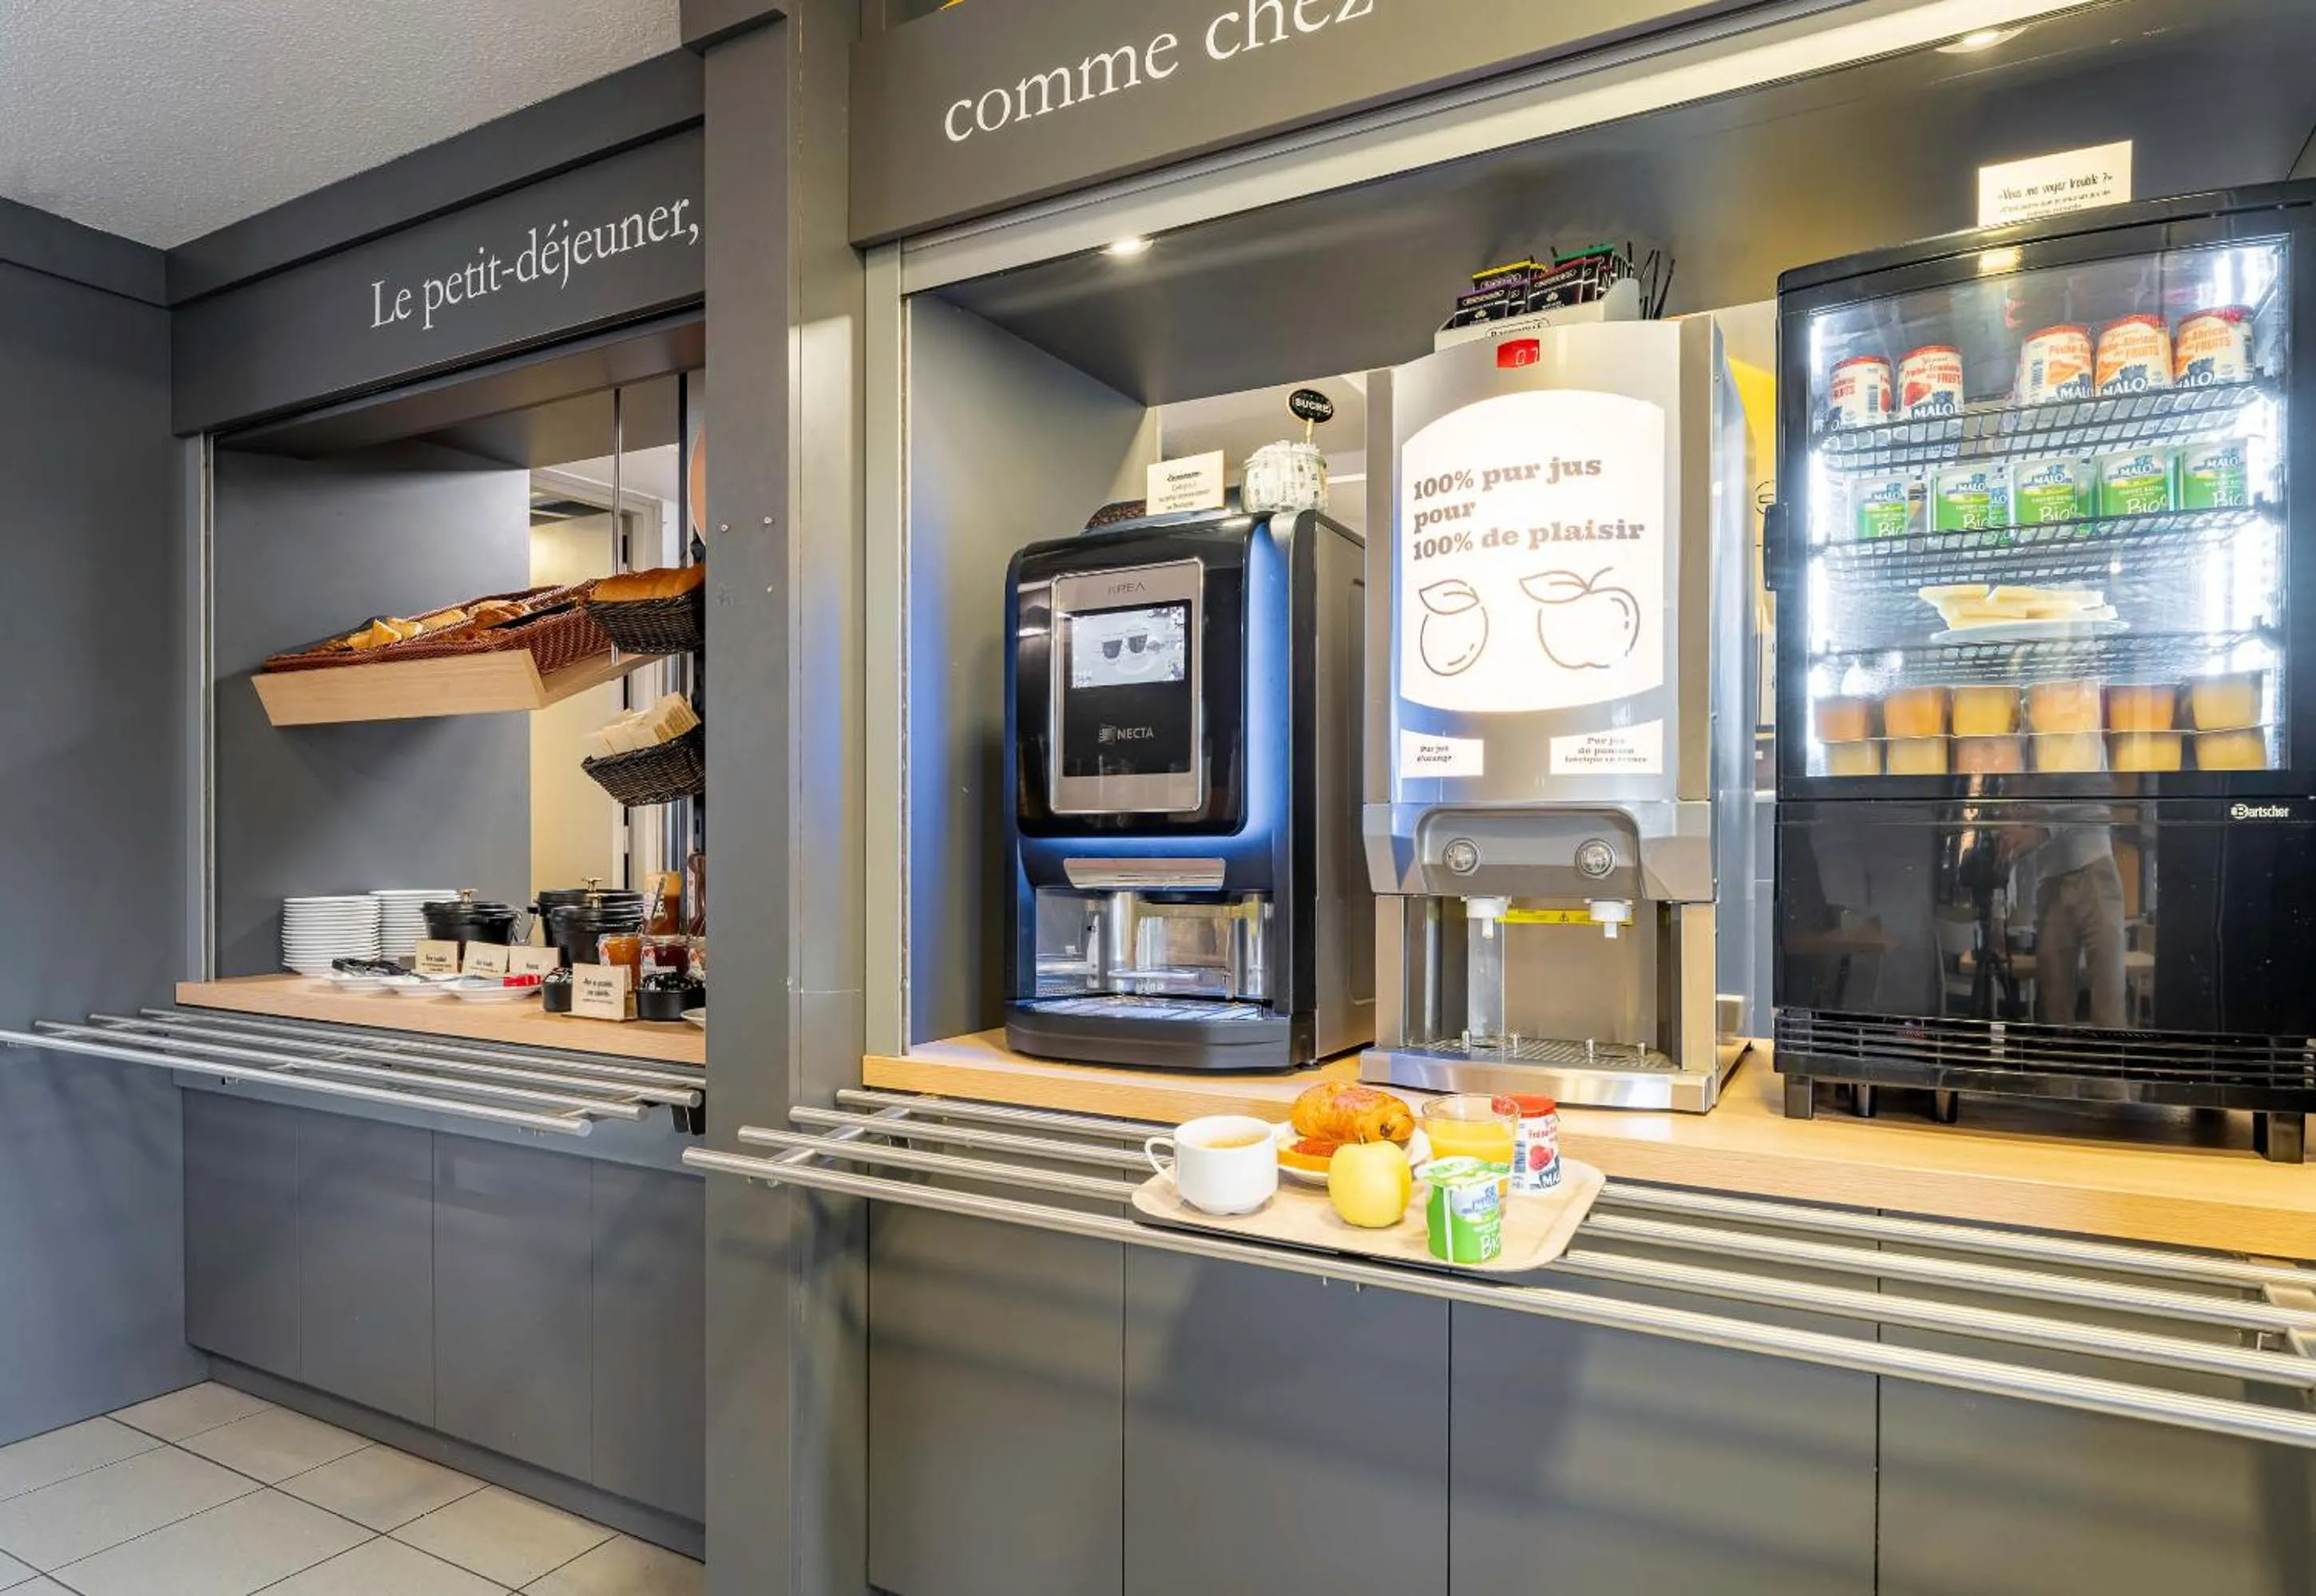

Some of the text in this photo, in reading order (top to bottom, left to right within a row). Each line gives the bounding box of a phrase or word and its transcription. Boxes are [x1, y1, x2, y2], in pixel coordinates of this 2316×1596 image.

[944, 32, 1179, 142] comme
[371, 198, 700, 331] Le petit-déjeuner,
[2060, 386, 2092, 400] MAL
[1913, 402, 1955, 418] MALO
[1414, 457, 1602, 500] 100% pur jus
[2126, 497, 2161, 515] Bio
[1414, 501, 1476, 534] pour
[1413, 519, 1645, 560] 100% de plaisir
[1108, 582, 1146, 595] KREA
[1117, 727, 1155, 740] NECTA
[2230, 803, 2290, 820] Bartscher
